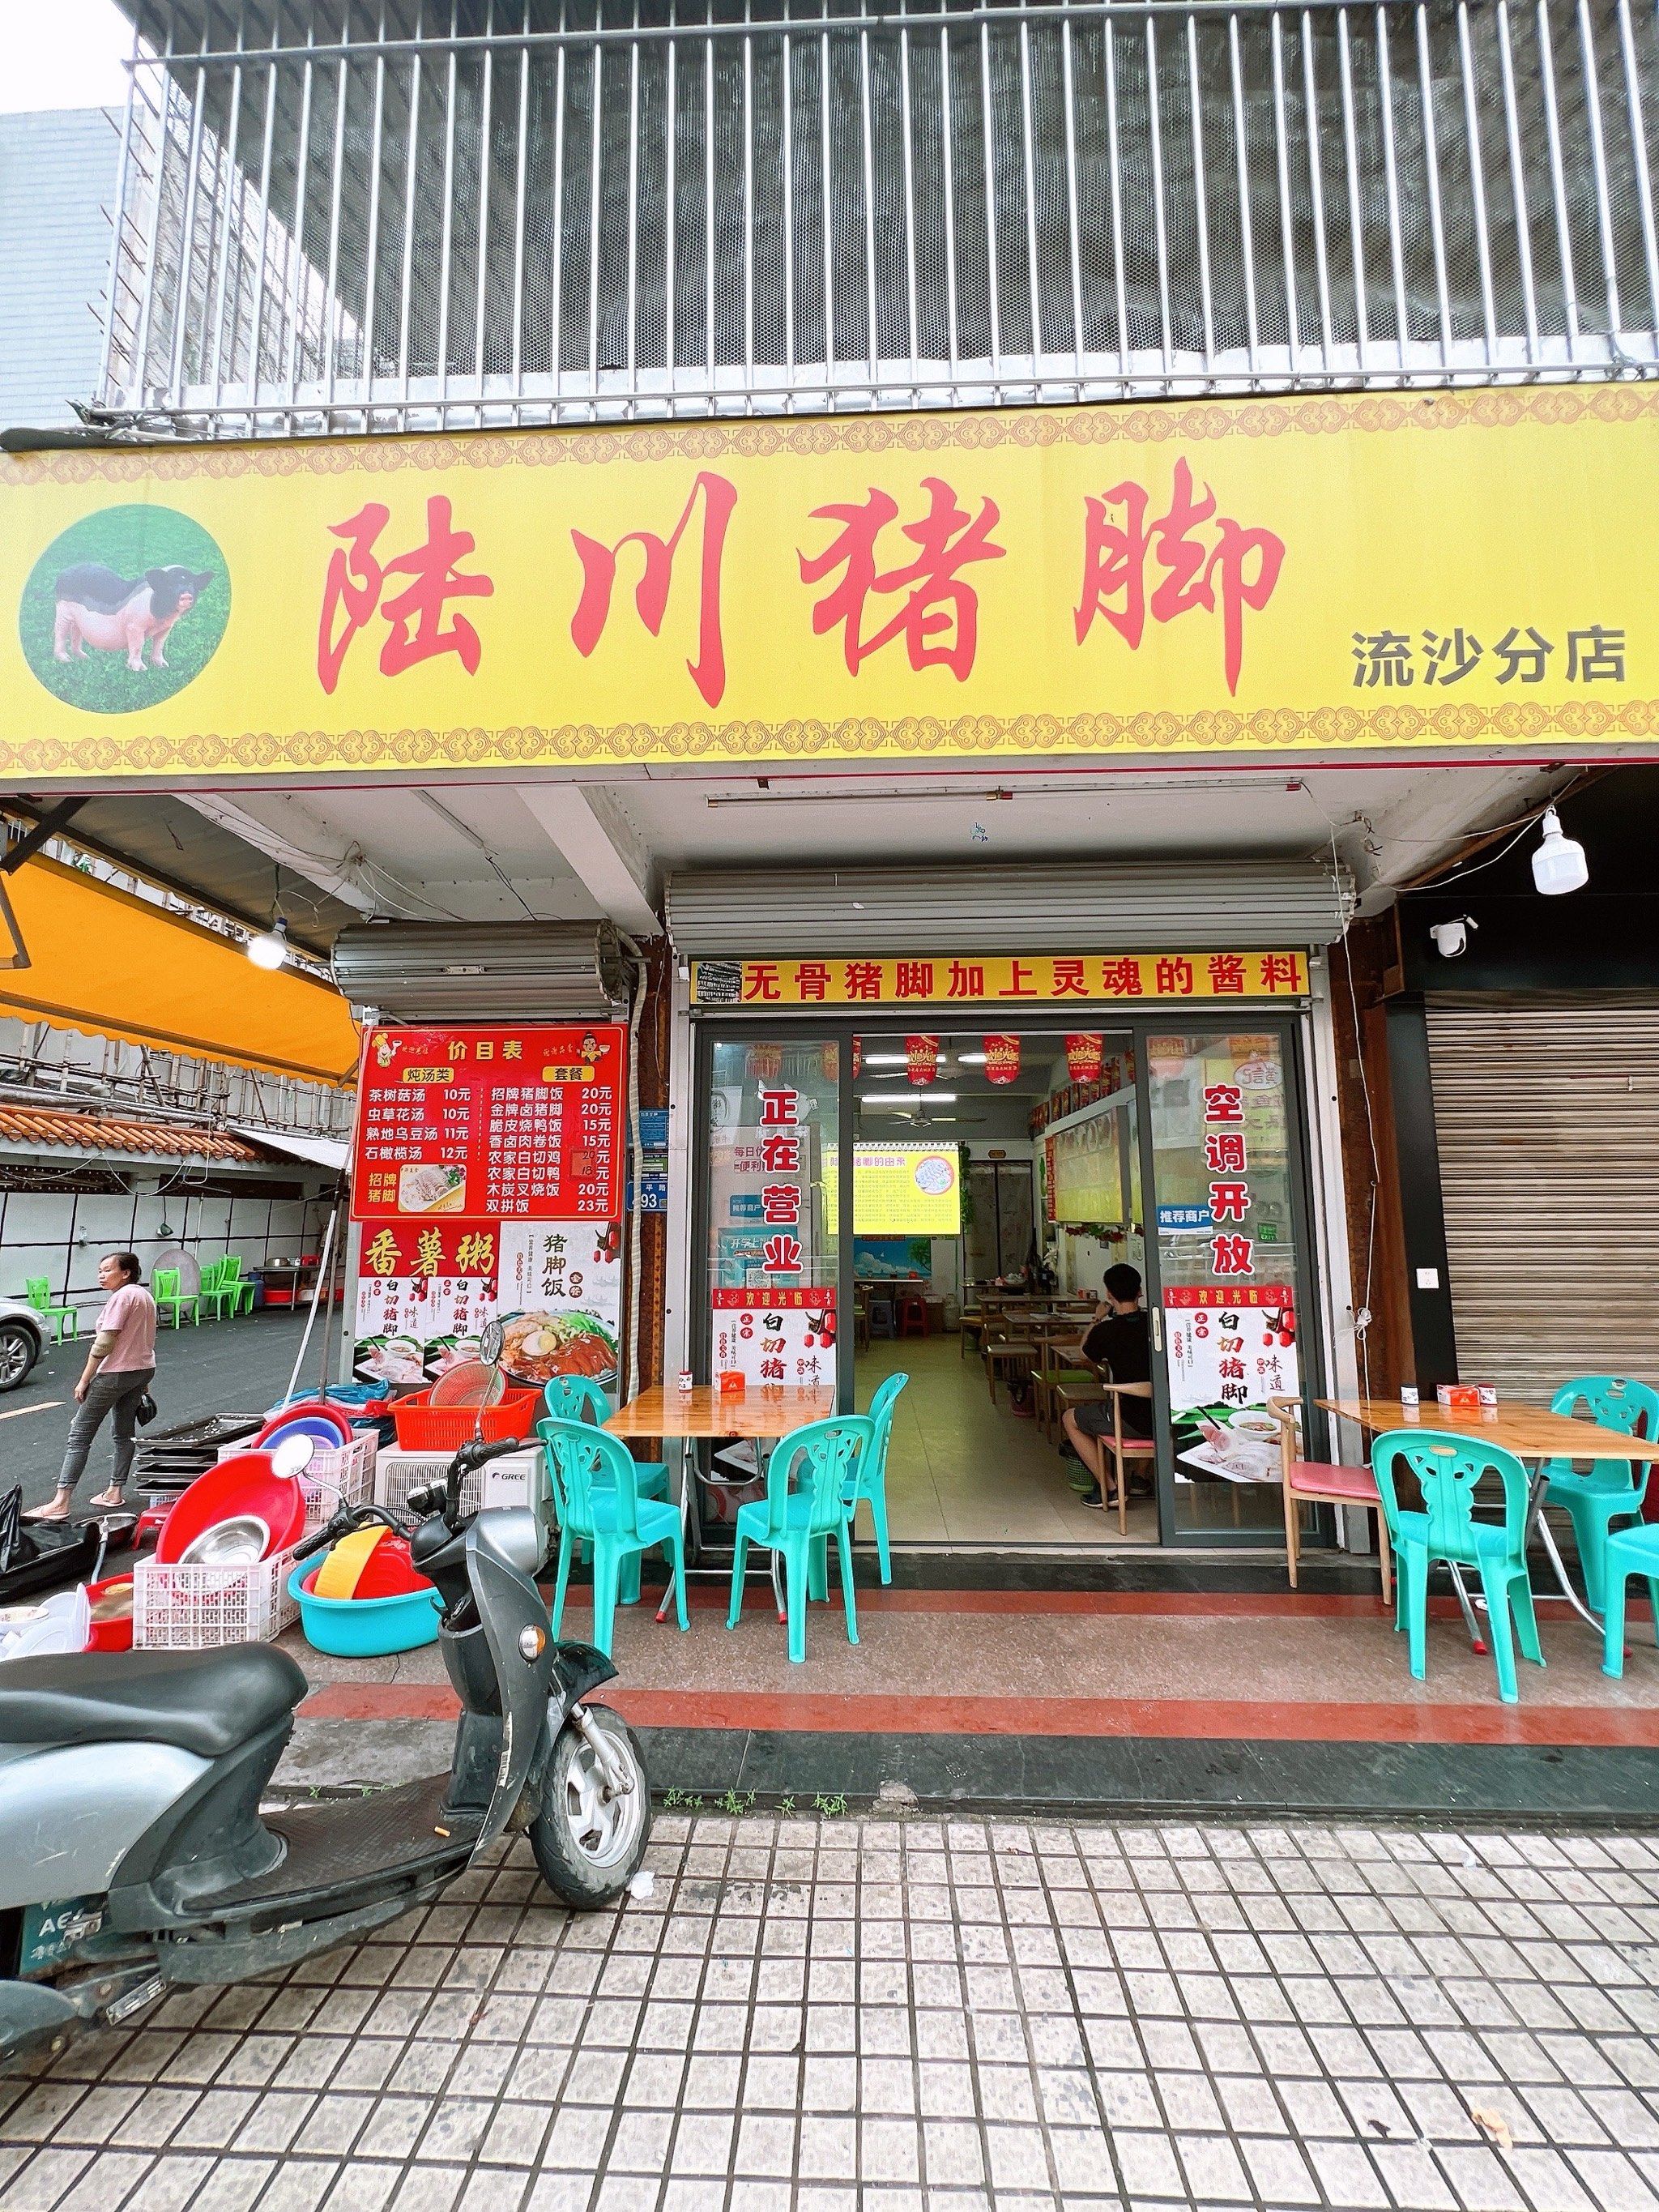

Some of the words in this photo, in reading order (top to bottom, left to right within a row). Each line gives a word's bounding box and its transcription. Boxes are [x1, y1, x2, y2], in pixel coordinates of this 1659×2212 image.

[318, 455, 1286, 709] 陆川猪脚
[1352, 625, 1627, 688] 流沙分店
[744, 954, 1302, 1001] 无骨猪脚加上灵魂的酱料
[448, 1040, 523, 1061] 价目表
[407, 1069, 450, 1083] 炖汤类
[555, 1067, 583, 1081] 套餐
[369, 1088, 425, 1102] 茶树菇汤
[444, 1088, 471, 1101] 10元
[491, 1087, 563, 1101] 招牌猪脚饭
[582, 1086, 612, 1100] 20元
[368, 1108, 424, 1121] 虫草花汤
[443, 1108, 470, 1121] 10元
[490, 1103, 563, 1117] 金牌卤猪脚
[581, 1102, 612, 1116] 20元
[489, 1118, 562, 1133] 脆皮烧鸭饭
[583, 1118, 611, 1132] 15元
[366, 1127, 437, 1141] 熟地乌豆汤
[445, 1126, 469, 1140] 11元
[488, 1134, 561, 1148] 香卤肉卷饭
[582, 1134, 611, 1147] 15元
[440, 1147, 467, 1159] 12元
[488, 1151, 561, 1164] 农家白切鸡
[369, 1172, 397, 1187] 招牌
[487, 1167, 560, 1181] 农家白切鸭
[1203, 1083, 1256, 1275] 空调开放
[760, 1090, 804, 1274] 正在营业
[368, 1189, 396, 1202] 猪脚
[486, 1183, 560, 1197] 木炭叉烧饭
[578, 1183, 609, 1197] 20元
[486, 1199, 529, 1213] 双拼饭
[577, 1198, 608, 1213] 23元
[633, 1194, 657, 1208] 93
[1160, 1210, 1210, 1223] 推荐商户
[365, 1226, 495, 1277] 番薯粥
[541, 1234, 568, 1297] 猪脚饭
[746, 1292, 803, 1306] 欢迎光临
[1199, 1289, 1258, 1304] 欢迎光临
[383, 1279, 399, 1336] 白切猪脚
[453, 1279, 469, 1336] 白切猪脚
[760, 1312, 787, 1380] 白切猪
[1217, 1311, 1247, 1404] 白切猪脚
[1265, 1354, 1286, 1391] 味道
[501, 1473, 526, 1481] GREE
